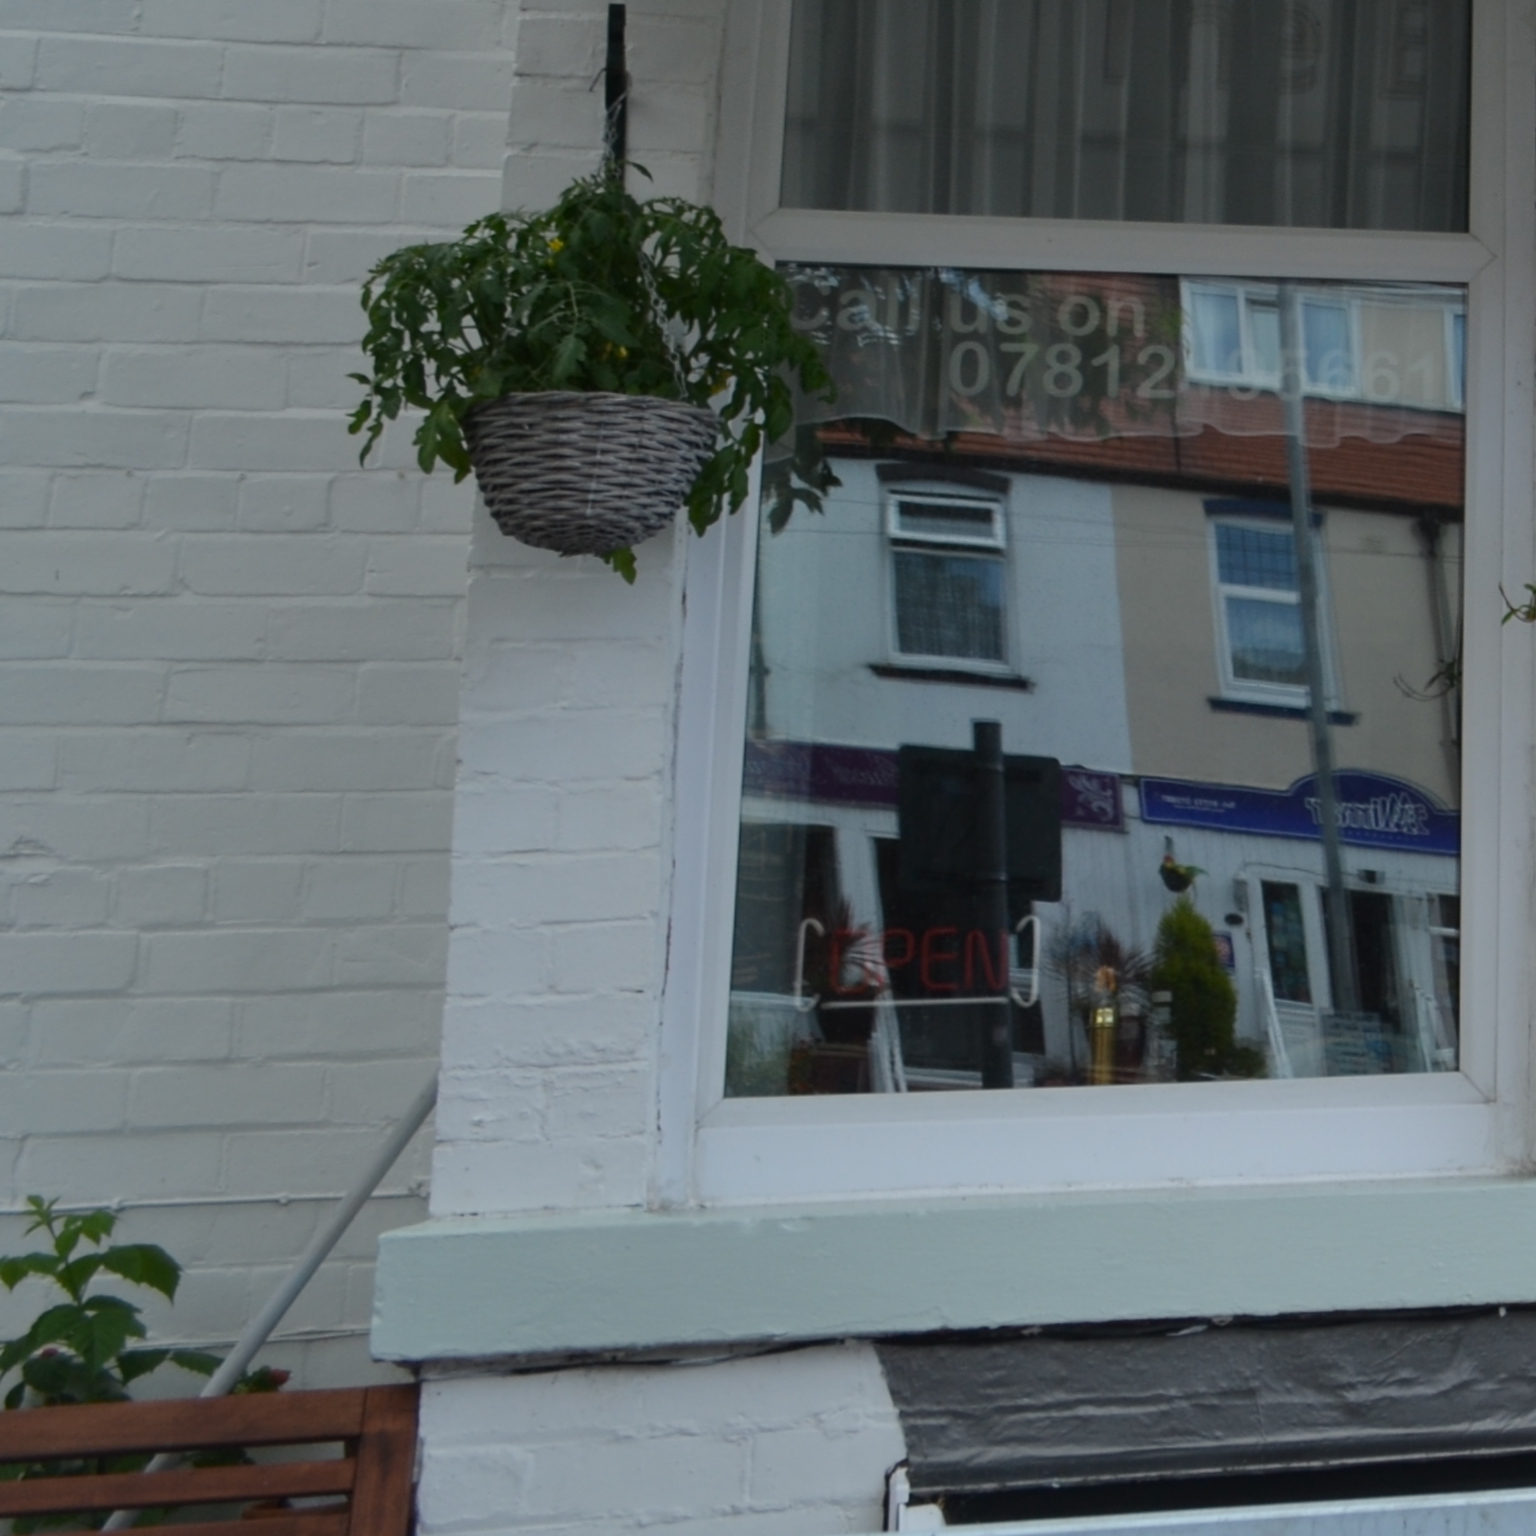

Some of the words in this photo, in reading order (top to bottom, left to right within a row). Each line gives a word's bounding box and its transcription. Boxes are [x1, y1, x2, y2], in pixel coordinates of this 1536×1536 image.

[788, 276, 921, 337] Call
[950, 293, 1033, 336] us
[1058, 294, 1147, 339] on
[829, 926, 1009, 995] OPEN
